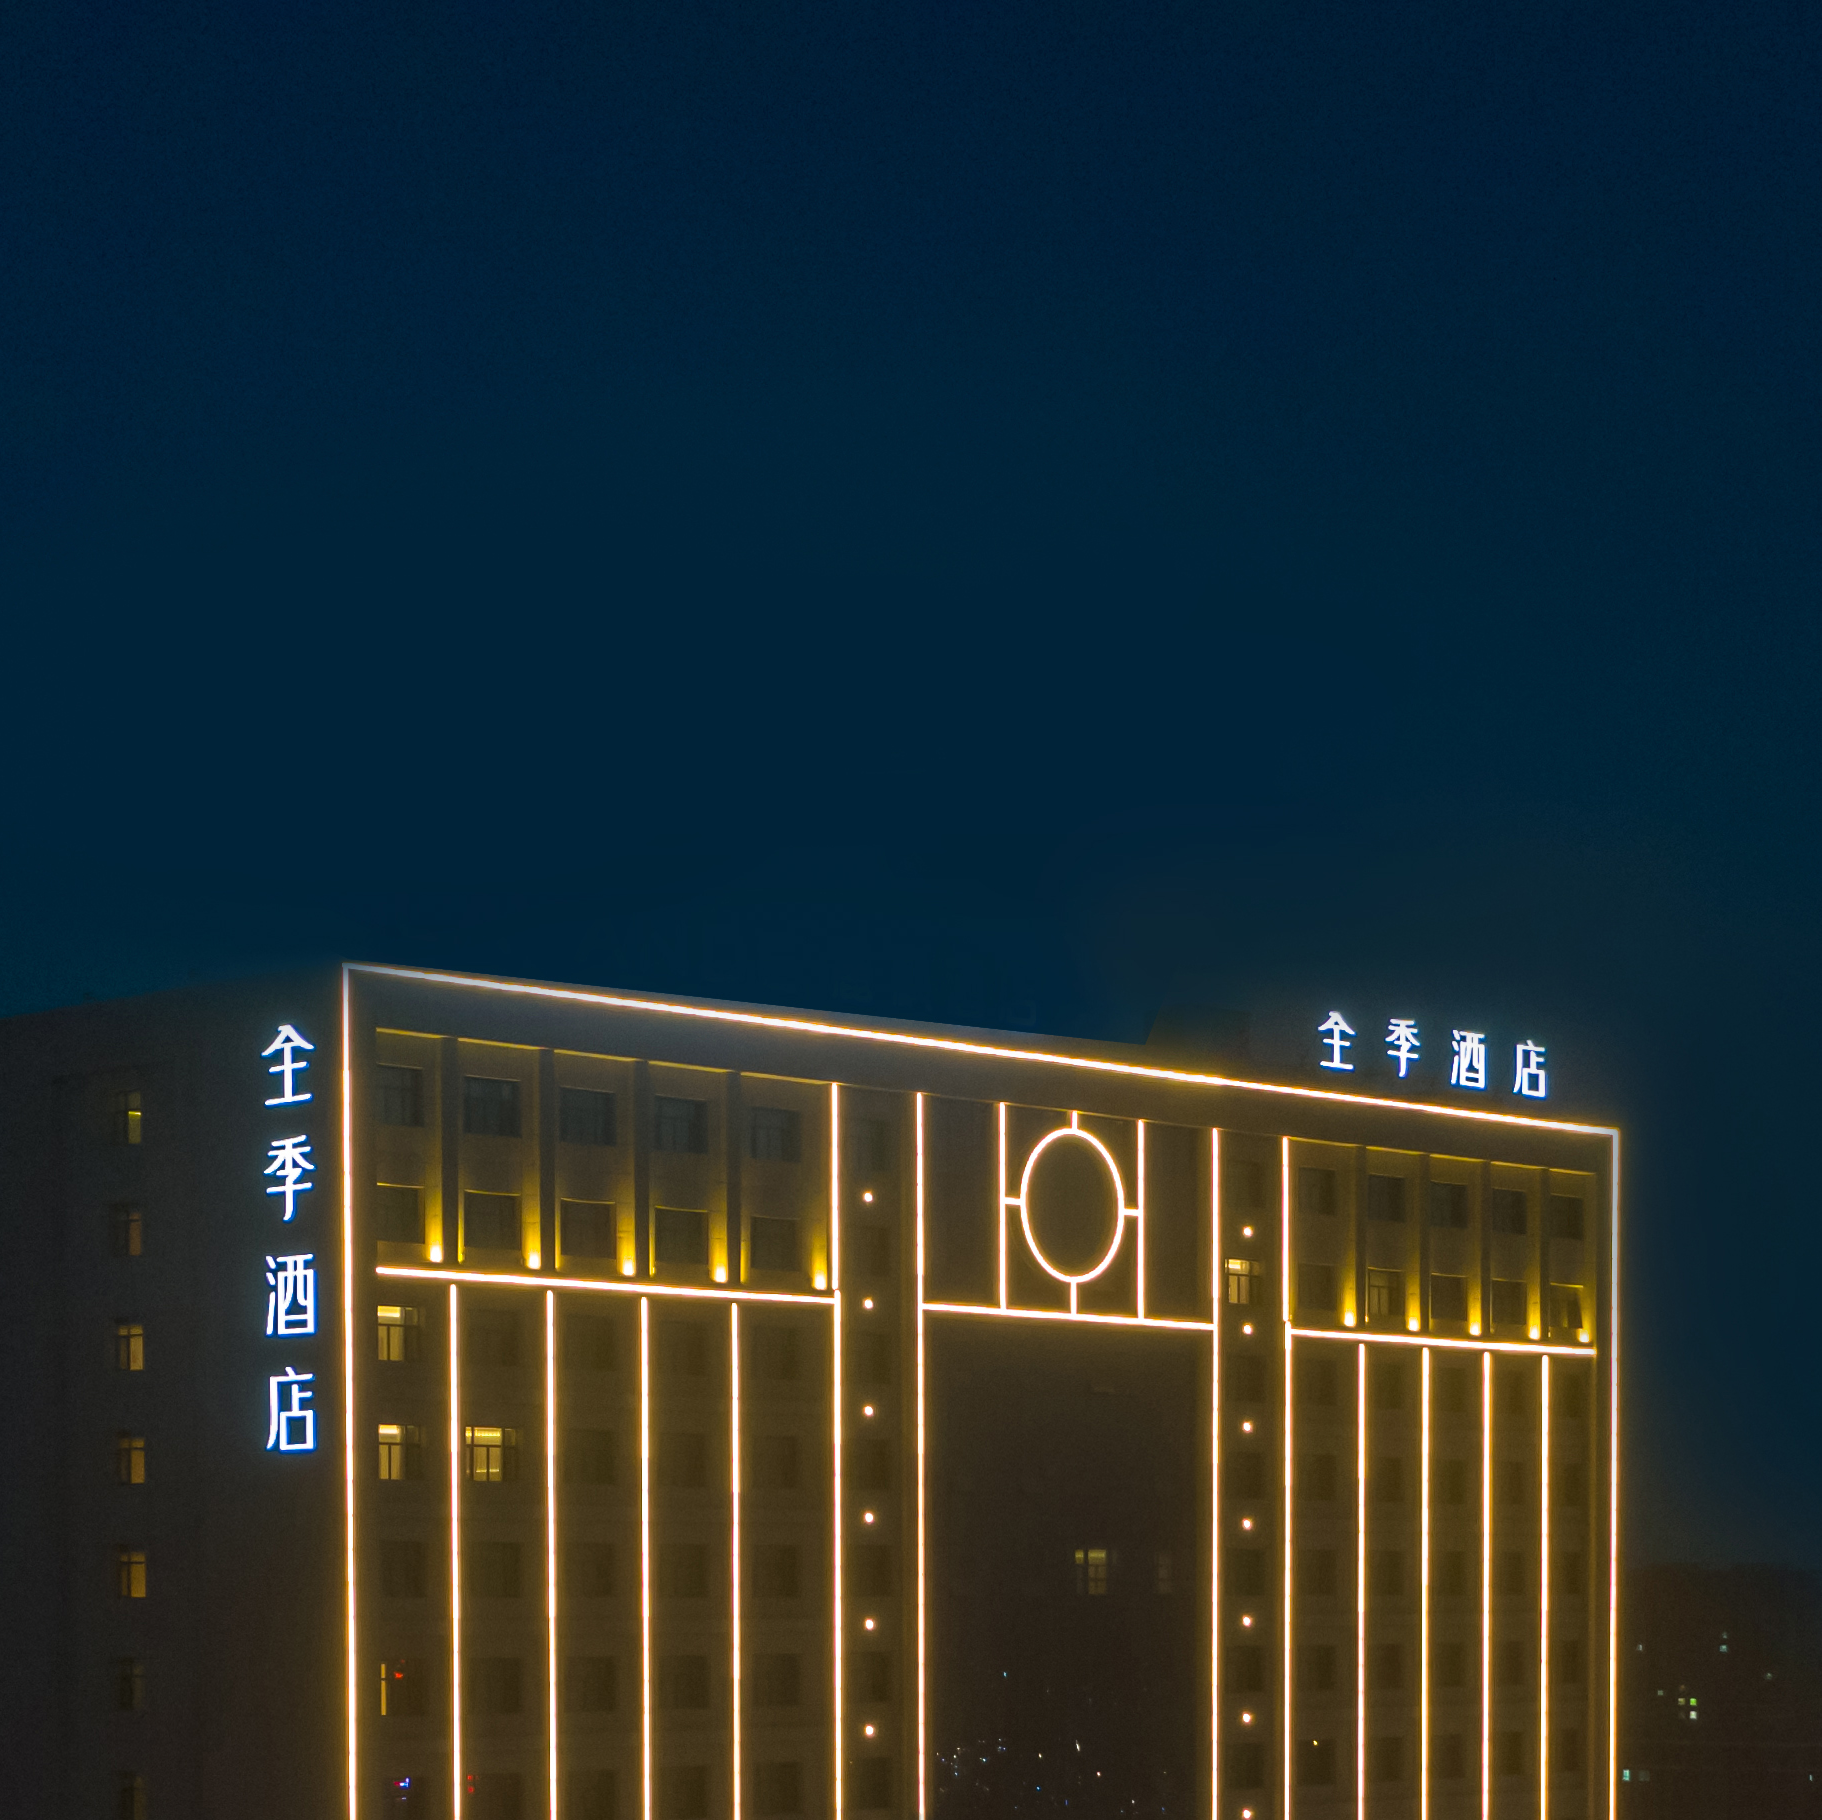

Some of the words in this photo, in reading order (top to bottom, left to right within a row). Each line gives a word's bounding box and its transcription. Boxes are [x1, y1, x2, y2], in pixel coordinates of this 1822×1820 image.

[1317, 1010, 1548, 1098] 全季酒店
[261, 1023, 319, 1453] 全季酒店
